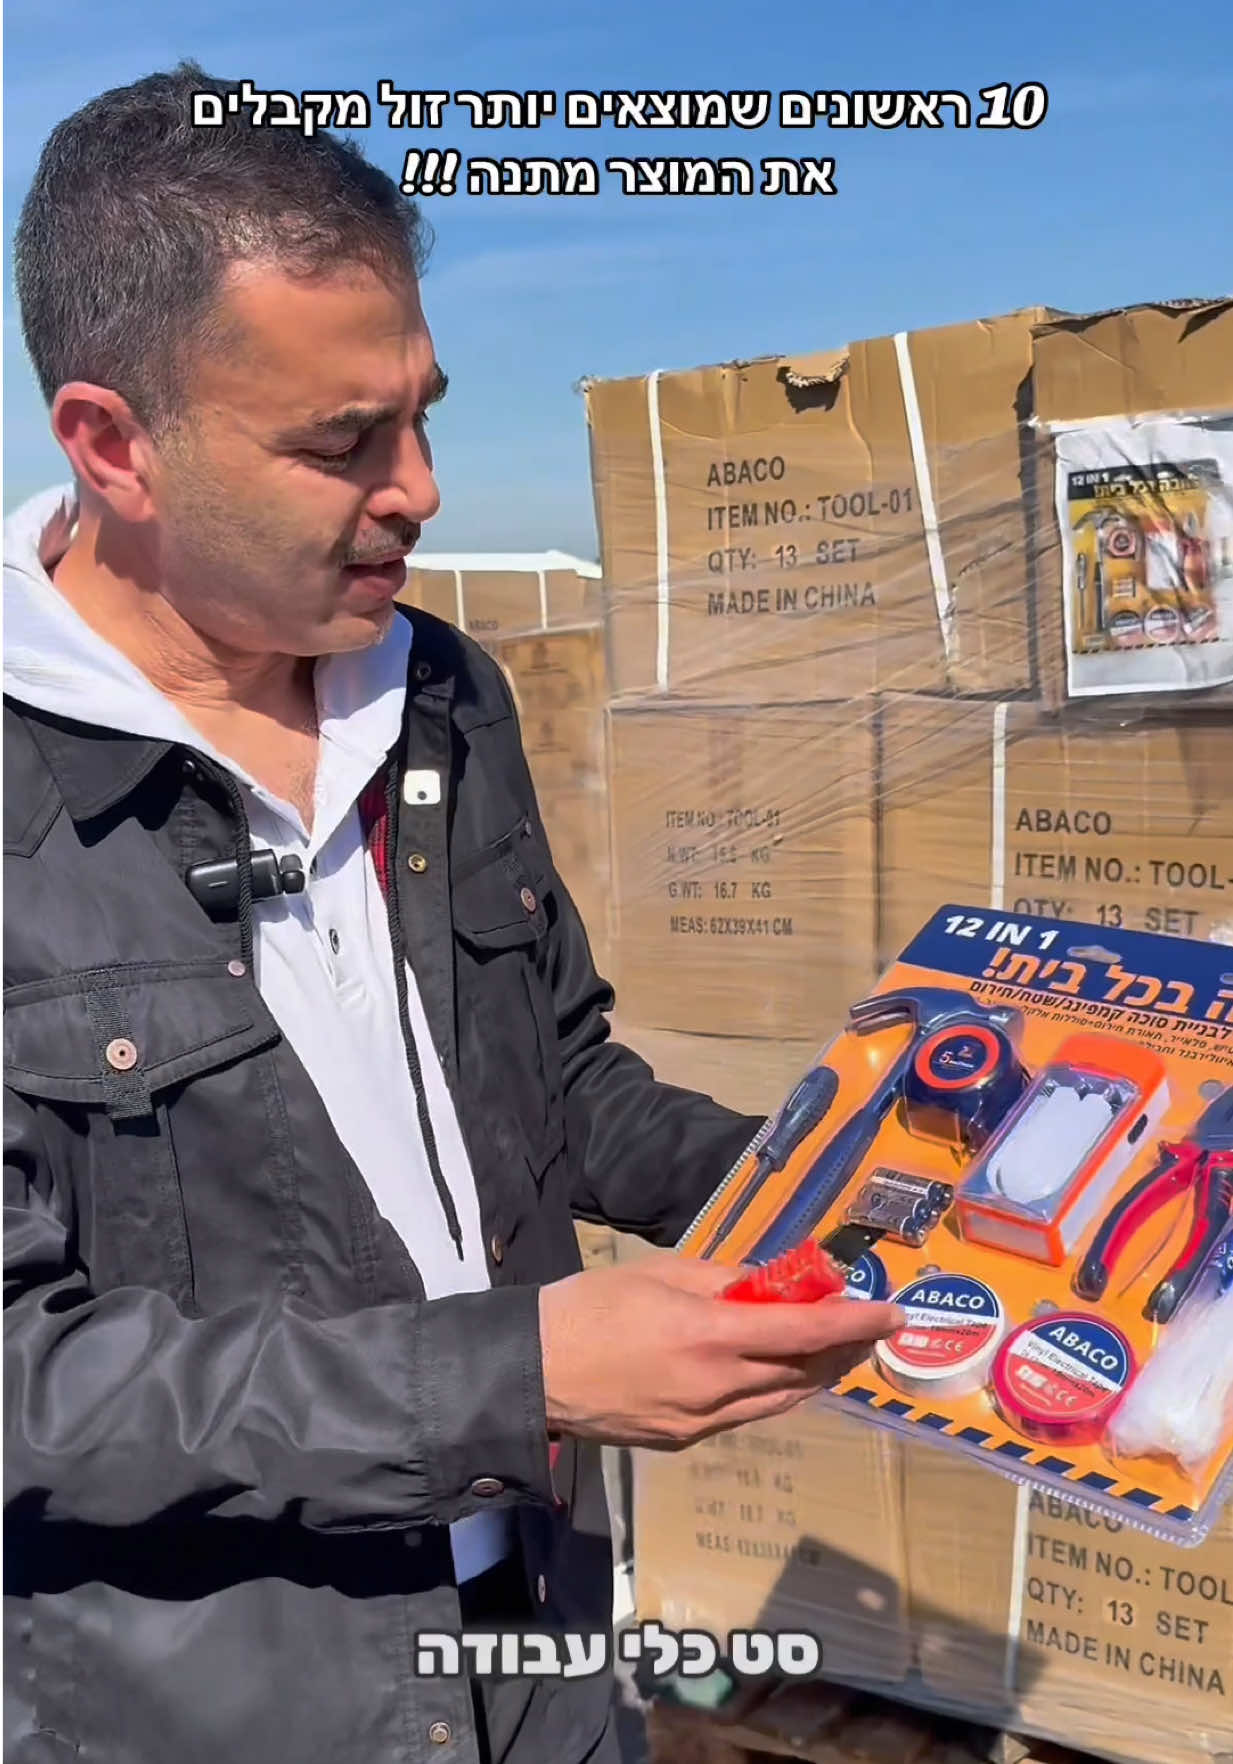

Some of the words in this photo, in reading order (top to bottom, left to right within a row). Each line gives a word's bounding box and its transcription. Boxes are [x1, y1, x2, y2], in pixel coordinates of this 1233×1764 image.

[707, 456, 785, 487] ABACO
[707, 503, 758, 531] ITEM
[817, 488, 913, 521] TOOL-01
[707, 548, 757, 574] QTY:
[775, 545, 797, 569] 13
[816, 539, 860, 565] SET
[707, 589, 770, 616] MADE
[776, 588, 797, 612] IN
[804, 581, 876, 611] CHINA
[1015, 808, 1112, 836] ABACO
[1015, 852, 1076, 882] ITEM
[714, 880, 738, 899] 16.7
[751, 880, 772, 899] KG
[670, 914, 708, 935] MEAS:
[772, 917, 793, 936] CM
[945, 914, 985, 939] 12
[985, 921, 1033, 946] IN
[1038, 930, 1060, 951] 1
[1096, 904, 1122, 928] 13
[1144, 907, 1201, 935] SET
[981, 947, 1088, 995] בית!
[1102, 963, 1195, 1016] בכל
[1127, 1011, 1169, 1029] סוכה
[1171, 1018, 1233, 1040] לבניית
[911, 1288, 985, 1310] ABACO
[1048, 1325, 1119, 1371] ABACO
[1027, 1532, 1088, 1571] ITEM
[1027, 1577, 1083, 1614] QTY:
[1108, 1600, 1134, 1626] 13
[1156, 1611, 1209, 1644] SET
[1027, 1619, 1099, 1661] MADE
[1106, 1643, 1131, 1670] IN
[1140, 1652, 1225, 1696] CHINA
